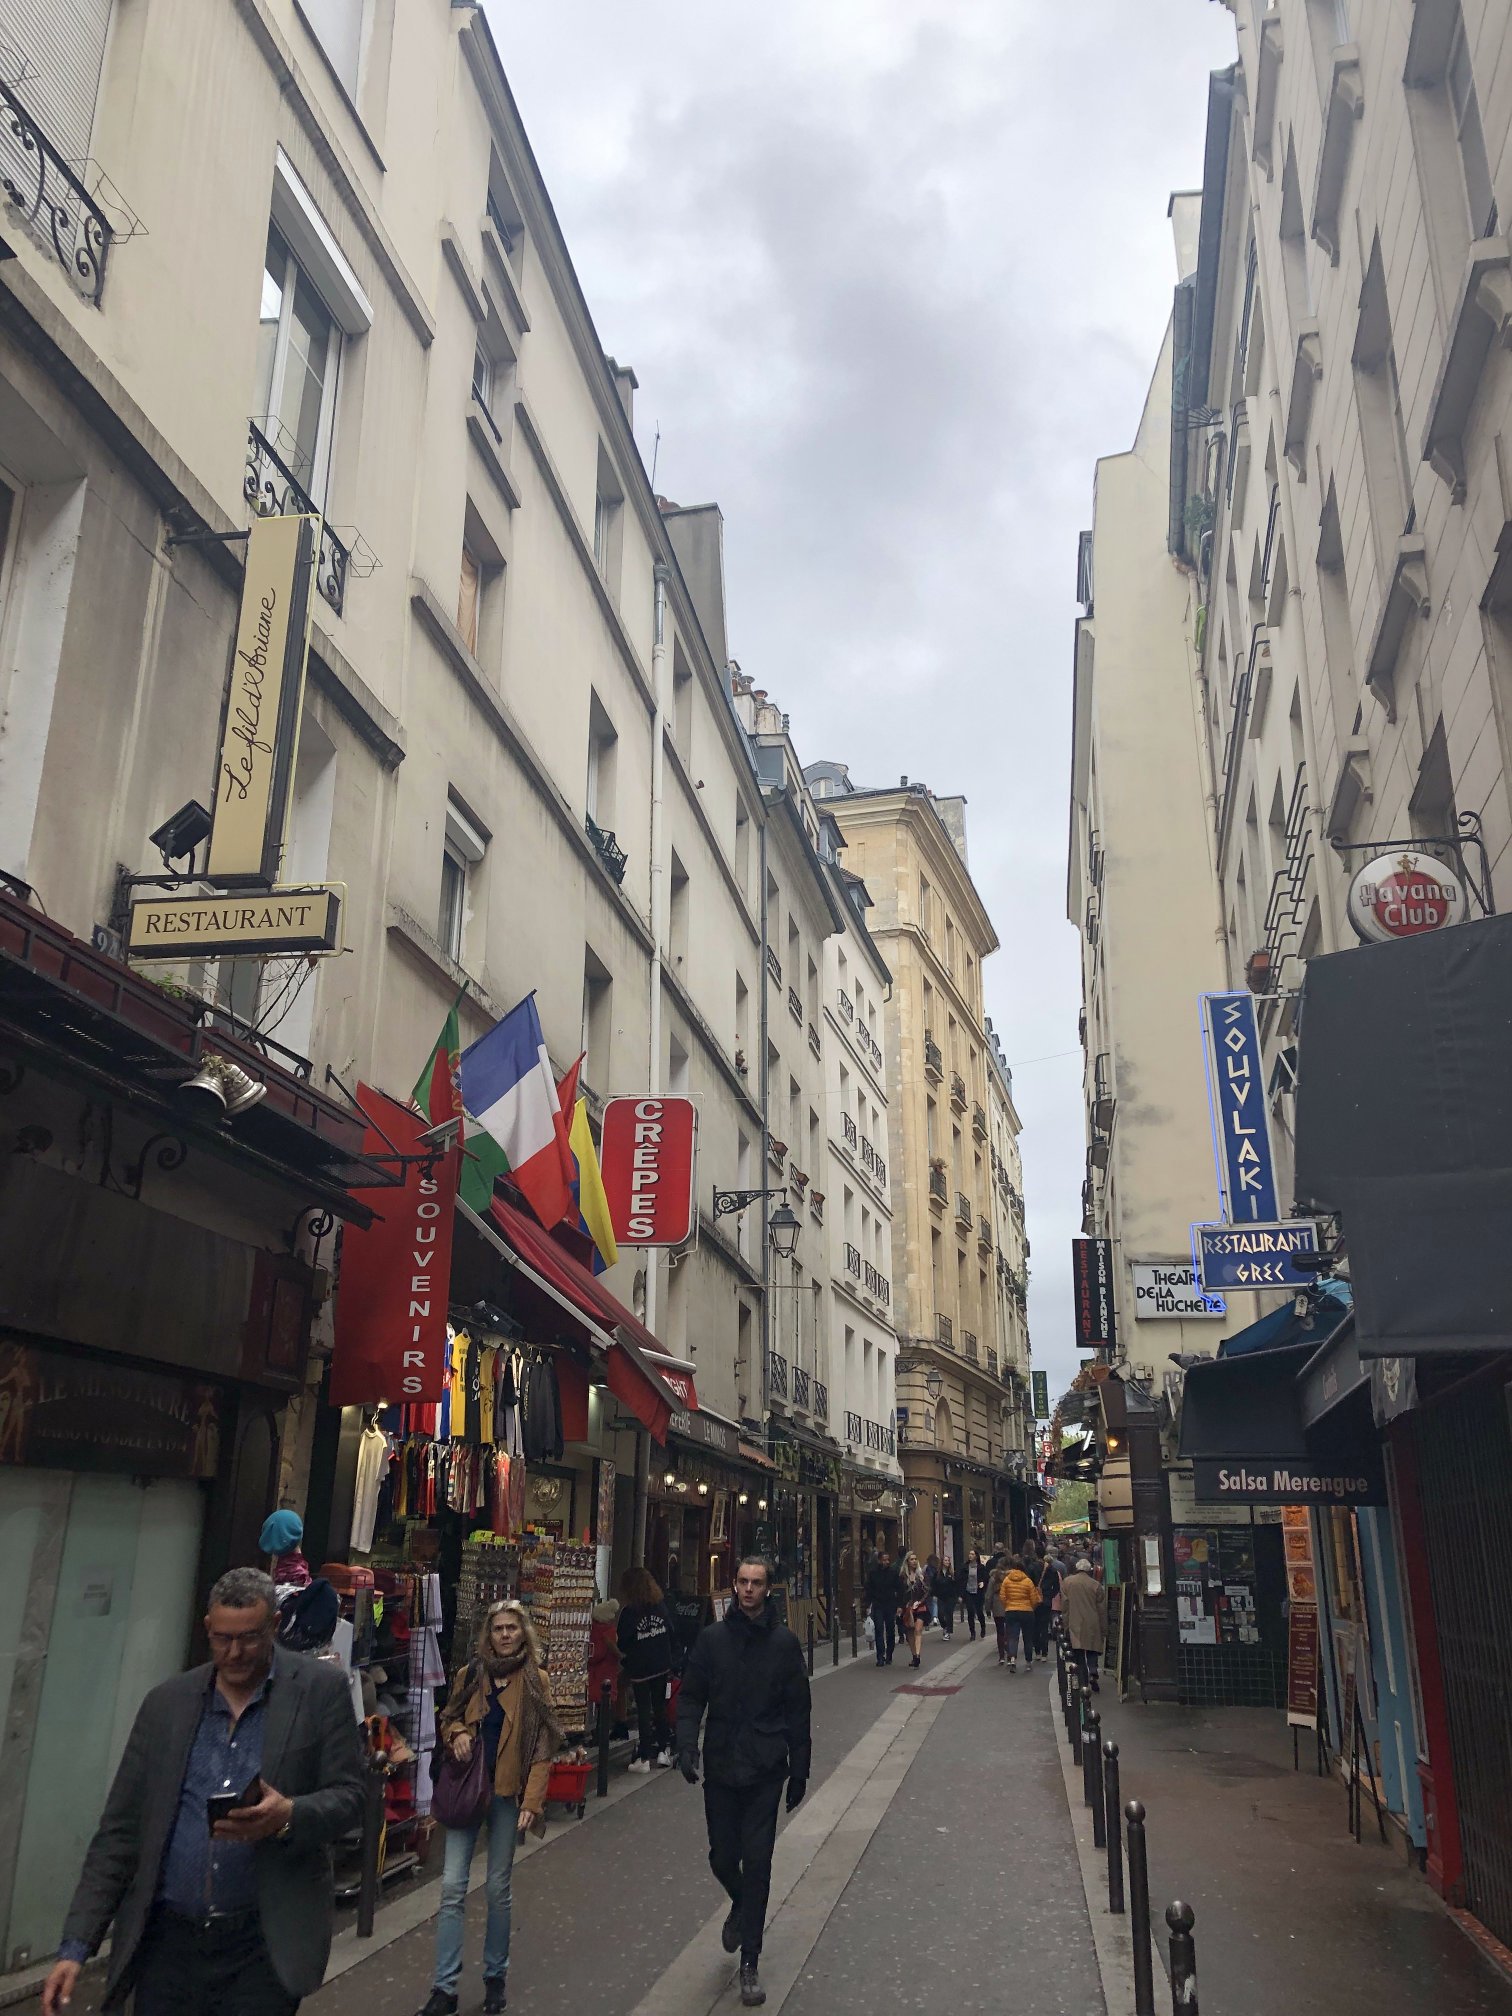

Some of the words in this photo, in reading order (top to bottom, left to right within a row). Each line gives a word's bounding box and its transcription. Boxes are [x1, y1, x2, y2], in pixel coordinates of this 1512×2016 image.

[231, 706, 273, 754] fil
[223, 756, 253, 802] Le
[1360, 882, 1456, 907] Havana
[144, 905, 312, 934] RESTAURANT
[1384, 903, 1438, 927] Club
[1222, 1001, 1263, 1220] SOUVLAKI
[627, 1099, 664, 1239] CRÊPES
[1204, 1231, 1311, 1255] RESTAURANT
[1096, 1240, 1107, 1284] MAISON
[1236, 1261, 1285, 1283] GREC
[403, 1178, 439, 1394] SOUVENIRS
[1080, 1240, 1092, 1338] RESTAURANT
[1137, 1287, 1155, 1299] DE
[1159, 1286, 1175, 1299] LA
[1099, 1286, 1109, 1339] BLANCHE
[38, 1376, 68, 1404] LE
[1219, 1469, 1268, 1491] Salsa
[1273, 1470, 1368, 1497] Merengue
